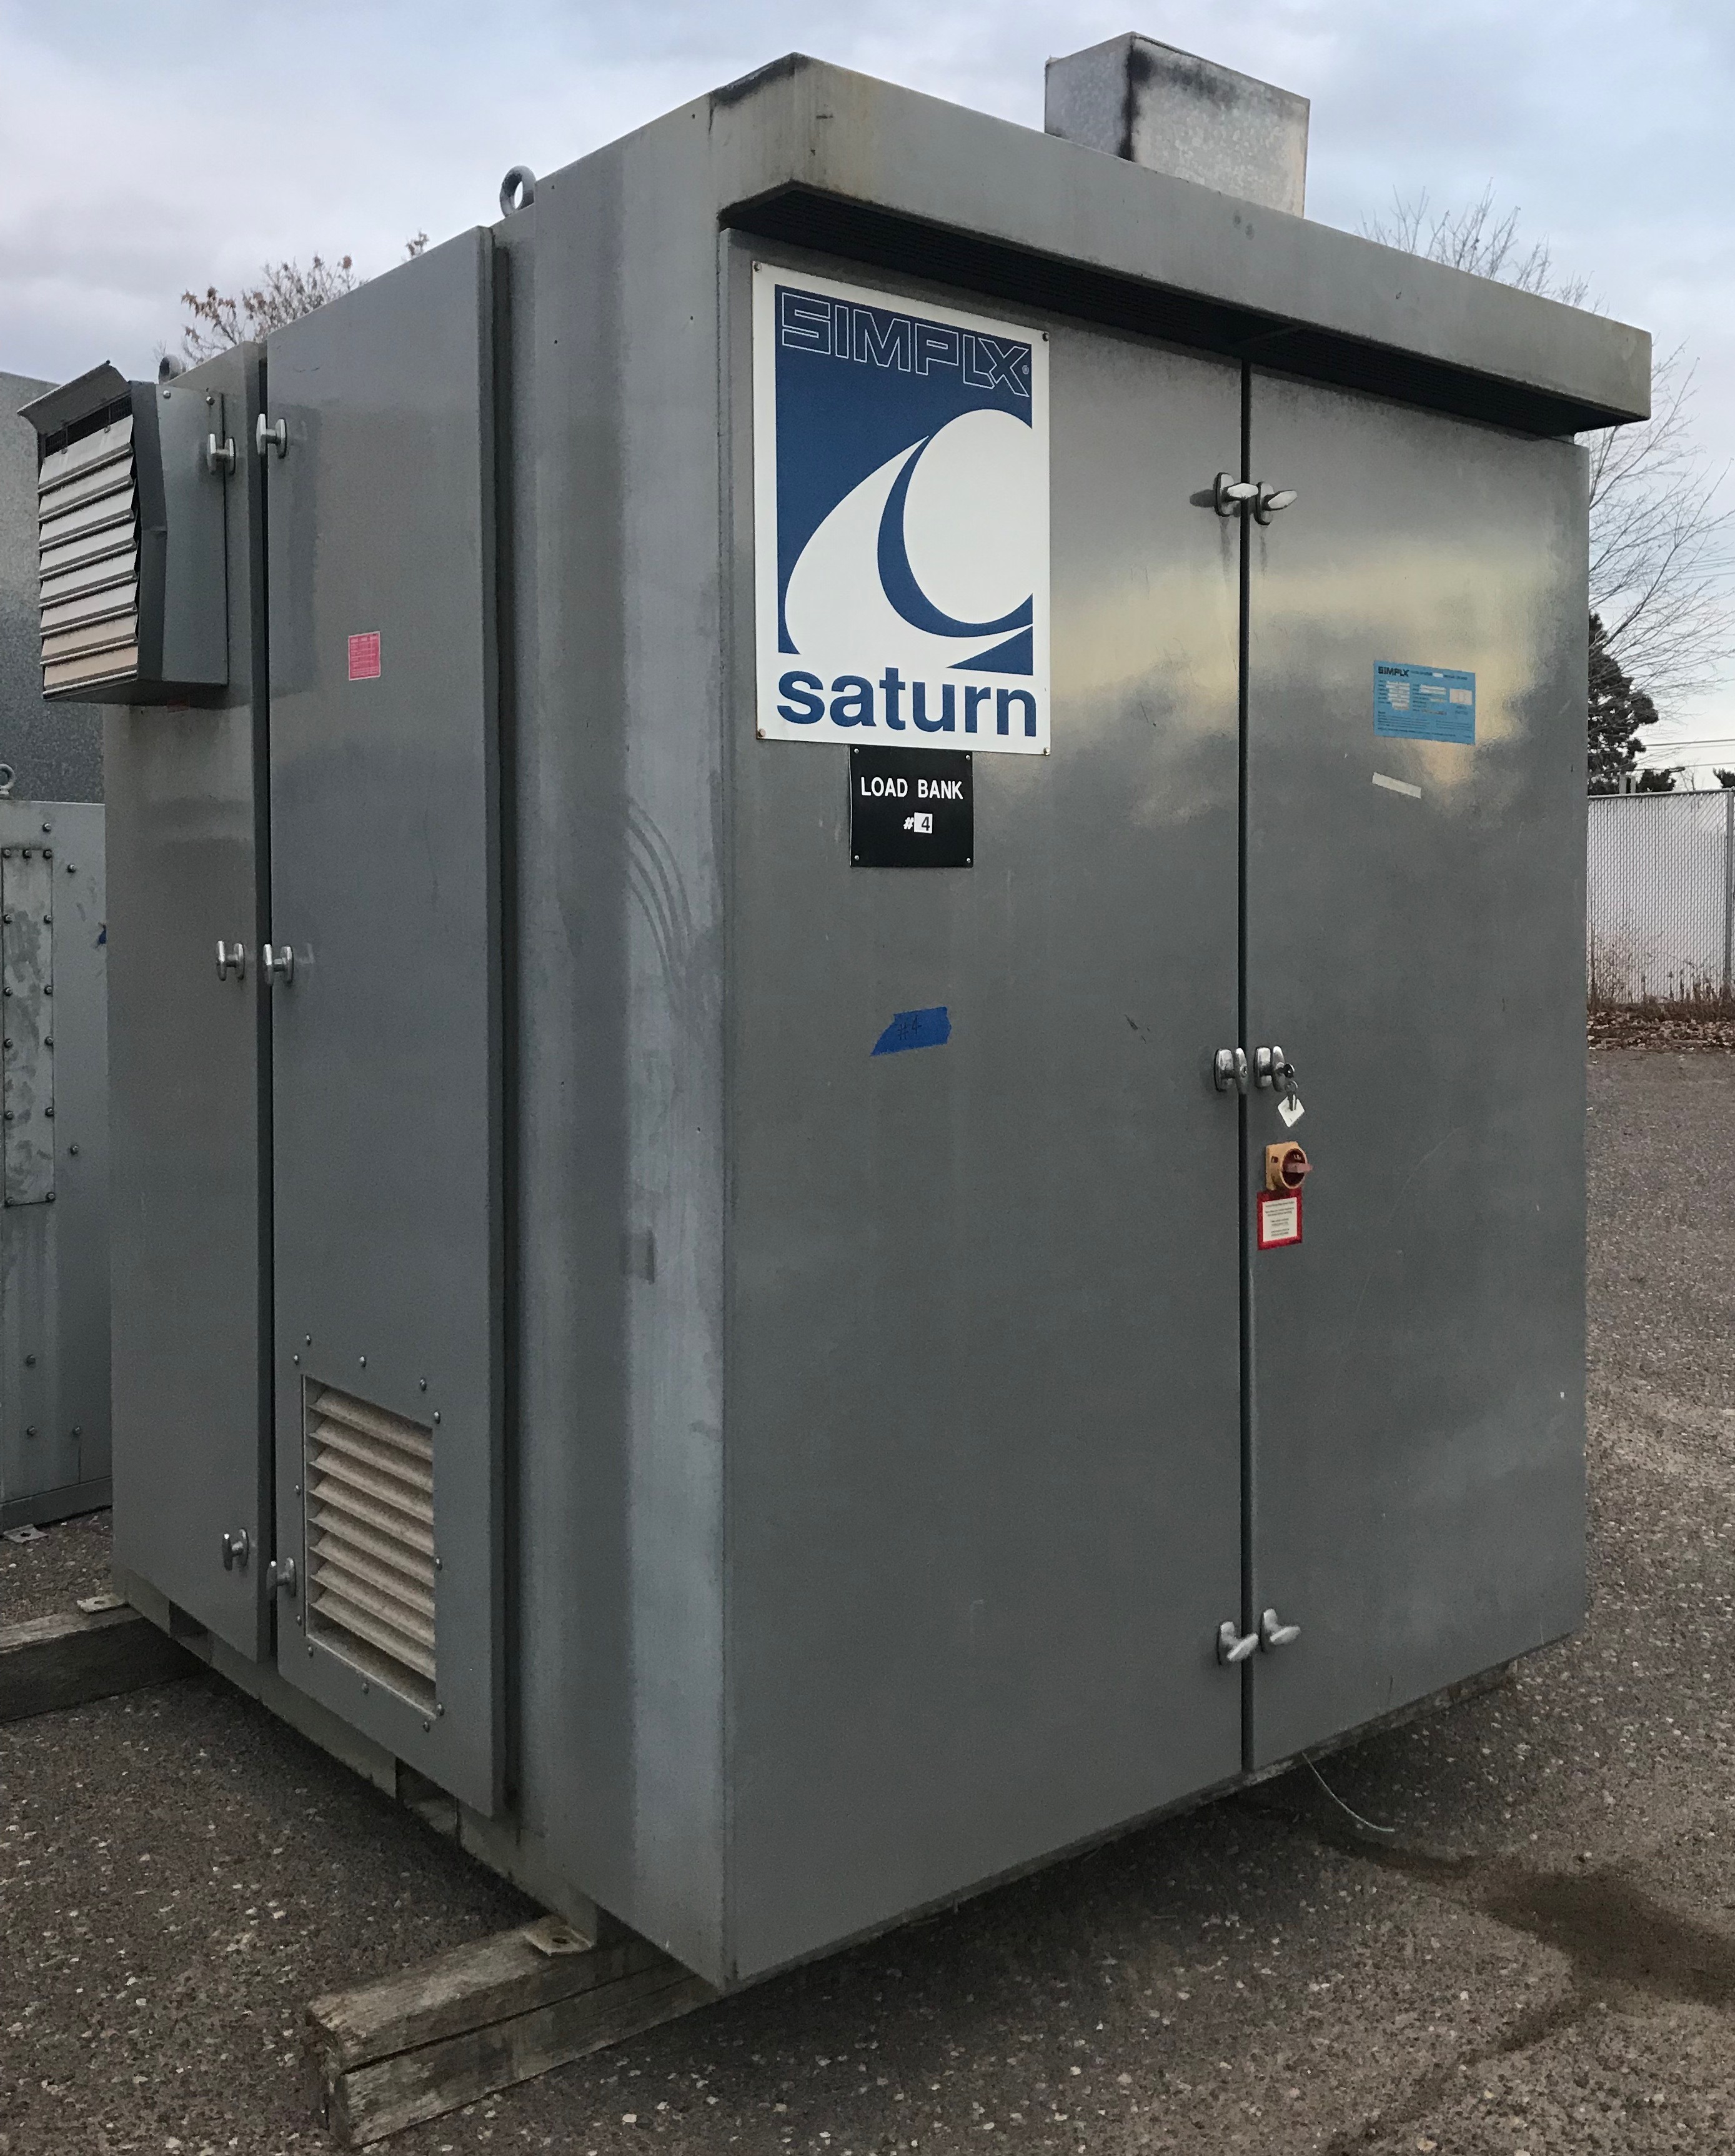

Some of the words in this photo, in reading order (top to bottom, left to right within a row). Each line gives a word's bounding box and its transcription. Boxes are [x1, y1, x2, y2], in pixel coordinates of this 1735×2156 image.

[777, 667, 1037, 737] saturn
[860, 776, 908, 797] LOAD
[918, 779, 963, 799] BANK
[897, 1014, 922, 1041] #4
